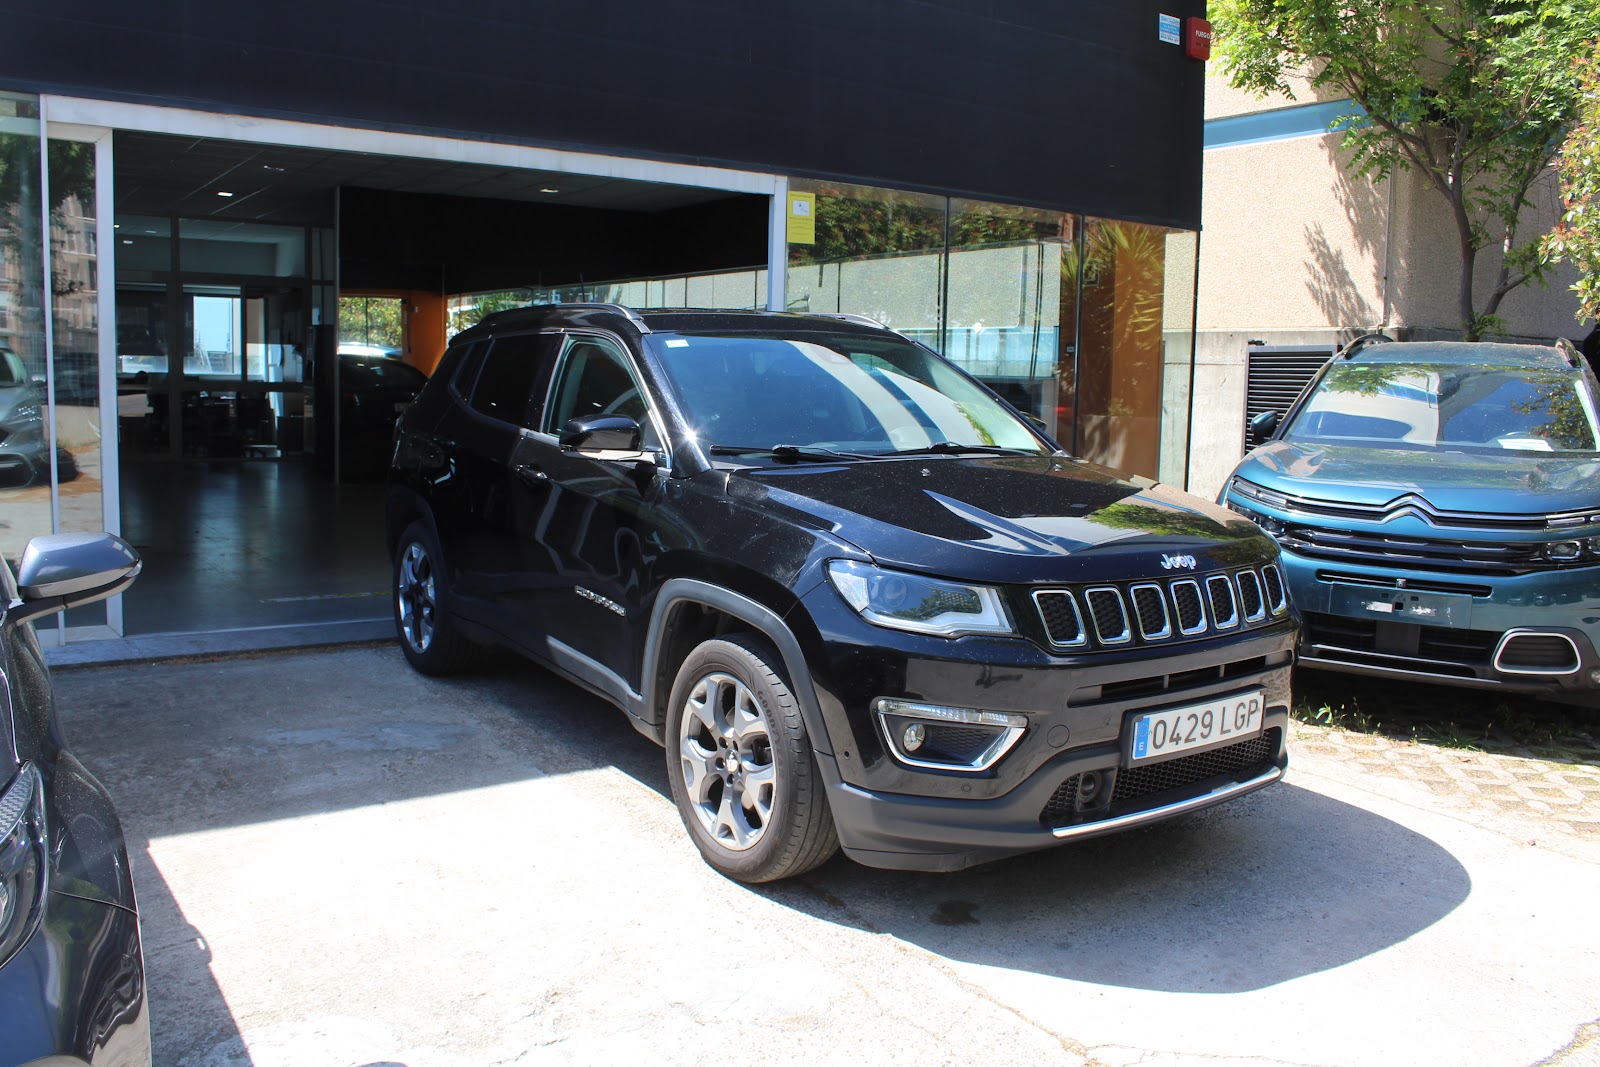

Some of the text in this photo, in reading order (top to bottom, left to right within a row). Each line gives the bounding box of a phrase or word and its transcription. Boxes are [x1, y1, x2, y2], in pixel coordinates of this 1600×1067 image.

[1195, 30, 1211, 40] FUEGO
[1161, 554, 1197, 570] Jeep
[1152, 699, 1259, 750] 0429 LGP
[1138, 741, 1145, 751] E
